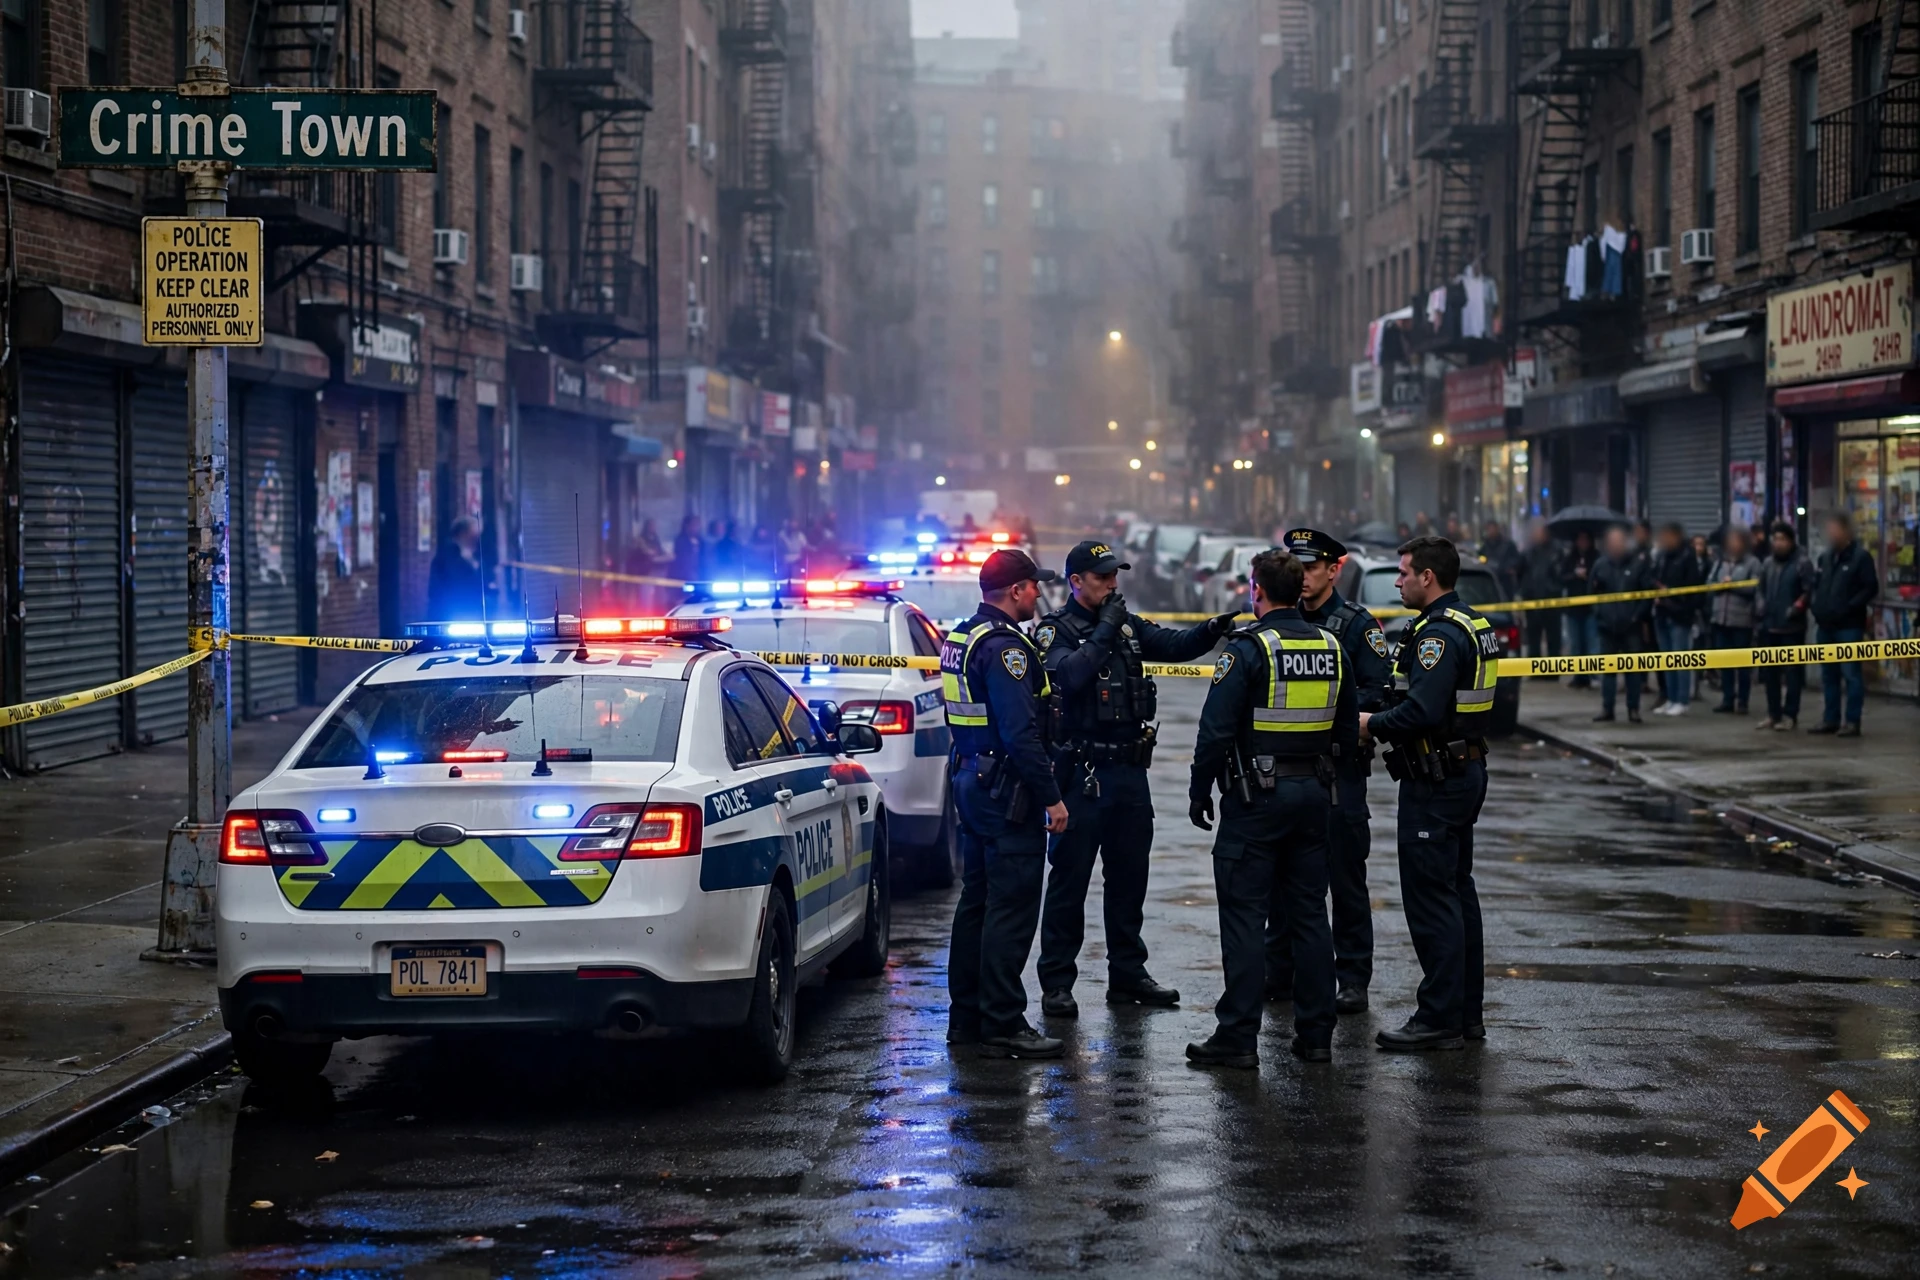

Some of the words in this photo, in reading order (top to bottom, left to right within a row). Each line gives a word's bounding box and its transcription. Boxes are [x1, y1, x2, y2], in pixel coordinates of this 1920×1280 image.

[89, 98, 248, 156] Crime
[272, 101, 407, 158] Town
[173, 227, 231, 247] POLICE
[156, 251, 248, 272] OPERATION
[156, 278, 195, 298] KEEP
[200, 278, 249, 298] CLEAR
[165, 303, 239, 318] AUTHORIZED
[1780, 276, 1894, 346] LAUNDROMAT
[152, 320, 220, 336] PERSONNEL
[225, 320, 254, 336] ONLY
[1872, 332, 1902, 363] 24HR
[1815, 344, 1842, 372] 24HR
[1292, 531, 1313, 540] POLICE
[309, 637, 350, 648] POLICE
[354, 639, 381, 650] LINE
[391, 640, 408, 651] DO
[1752, 648, 1795, 664] POLICE
[1798, 647, 1825, 662] LINE
[1836, 645, 1853, 660] DO
[1856, 644, 1881, 658] NOT
[416, 648, 658, 672] POLICE
[785, 652, 812, 665] LINE
[822, 653, 838, 666] DO
[842, 654, 866, 667] NOT
[869, 655, 908, 668] CROSS
[1282, 653, 1335, 676] POLICE
[1531, 658, 1575, 673] POLICE
[1578, 657, 1605, 672] LINE
[1617, 656, 1634, 670] DO
[1638, 655, 1662, 670] NOT
[1666, 653, 1707, 668] CROSS
[1166, 666, 1201, 676] CROSS
[712, 787, 752, 818] POLICE
[795, 819, 834, 882] POLICE
[399, 960, 429, 985] POL
[438, 960, 476, 985] 7841
